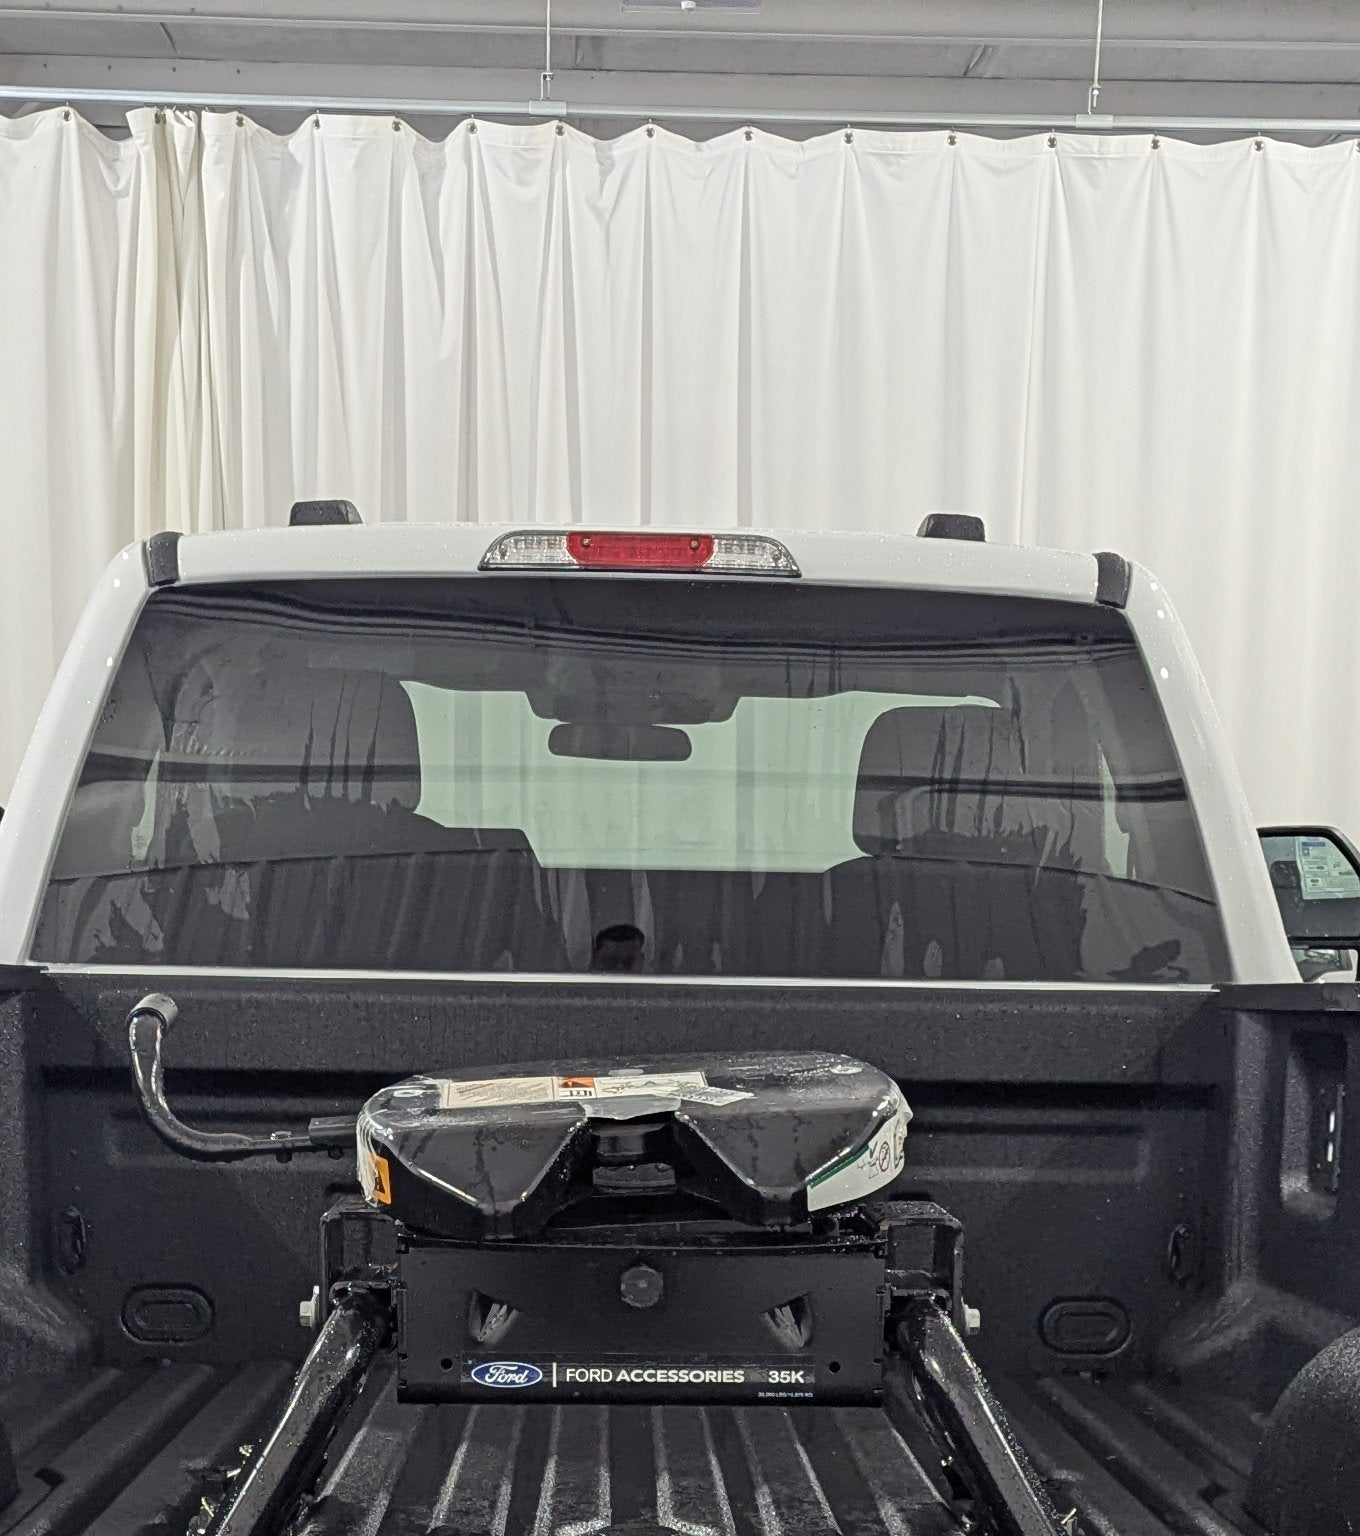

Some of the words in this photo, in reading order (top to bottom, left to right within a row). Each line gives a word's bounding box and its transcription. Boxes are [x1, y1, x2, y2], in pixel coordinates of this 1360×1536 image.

[484, 1364, 530, 1384] Ford
[566, 1368, 613, 1383] FORD
[616, 1369, 746, 1383] ACCESSORIES
[768, 1369, 805, 1384] 35K
